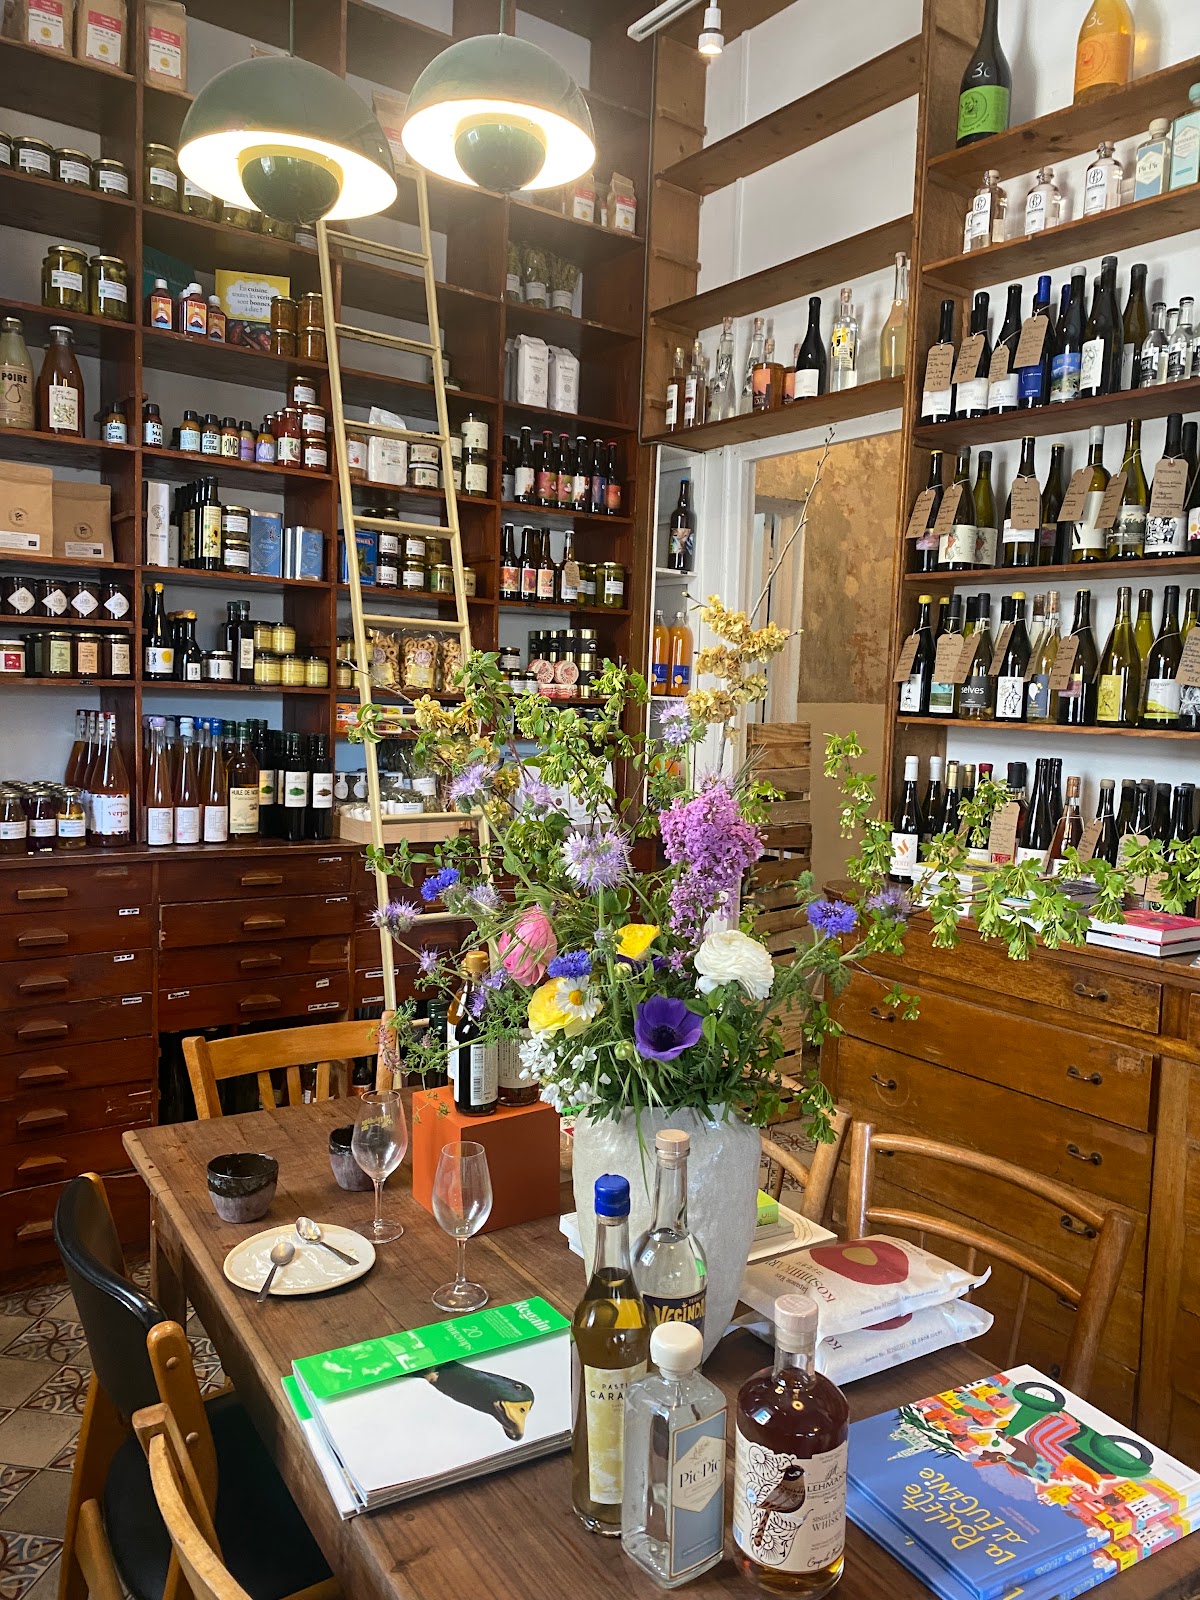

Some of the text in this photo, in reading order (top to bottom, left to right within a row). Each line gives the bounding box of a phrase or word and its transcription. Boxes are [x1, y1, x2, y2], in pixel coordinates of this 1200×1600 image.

[248, 286, 268, 294] cuisine
[1, 372, 28, 384] POIRE
[961, 685, 985, 695] selves
[511, 1300, 552, 1332] Regain
[462, 1325, 484, 1339] 20
[985, 1543, 1017, 1565] La
